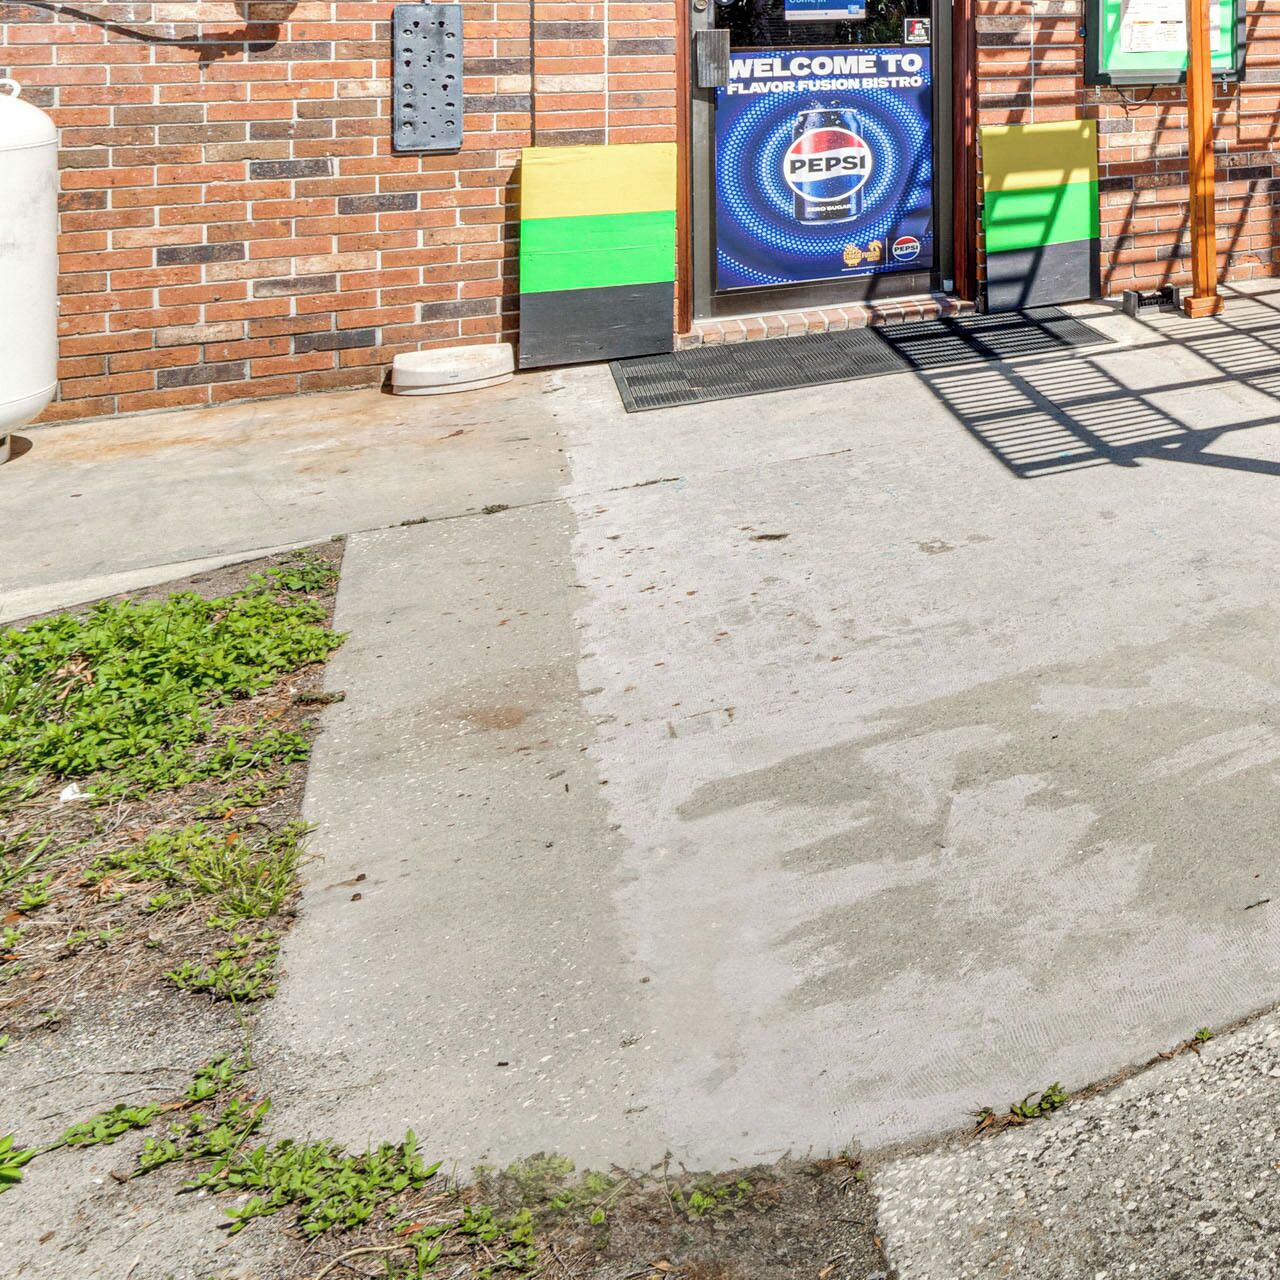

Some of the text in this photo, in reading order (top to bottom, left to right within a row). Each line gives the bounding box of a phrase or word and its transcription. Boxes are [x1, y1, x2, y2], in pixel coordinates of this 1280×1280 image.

[729, 53, 923, 78] WELCOME TO
[727, 76, 922, 95] FLAVOR FUSION BISTRO
[790, 155, 866, 174] PEPSI
[894, 244, 919, 253] PEPSI
